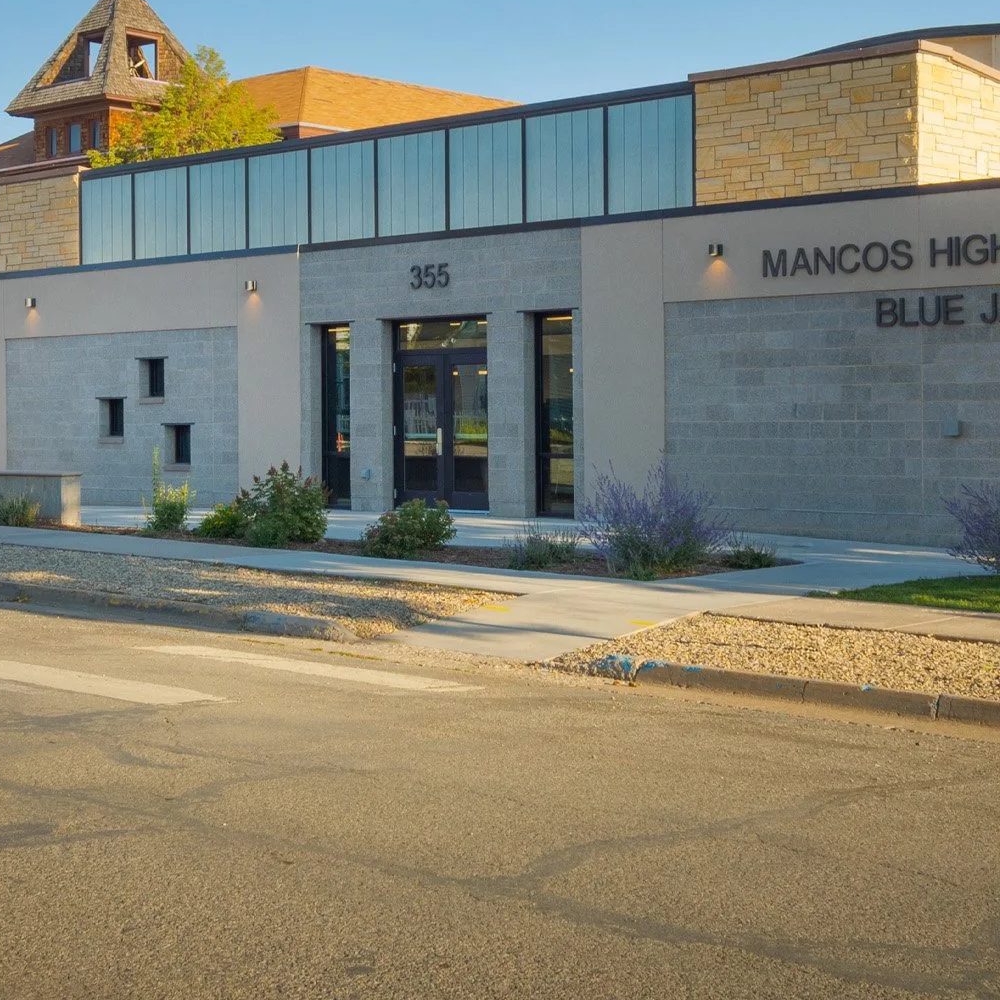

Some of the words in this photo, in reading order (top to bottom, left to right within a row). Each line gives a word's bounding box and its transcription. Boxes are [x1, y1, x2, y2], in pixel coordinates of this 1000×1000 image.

[762, 239, 914, 278] MANCOS
[410, 263, 450, 290] 355
[875, 293, 965, 328] BLUE
[980, 293, 1000, 325] J
